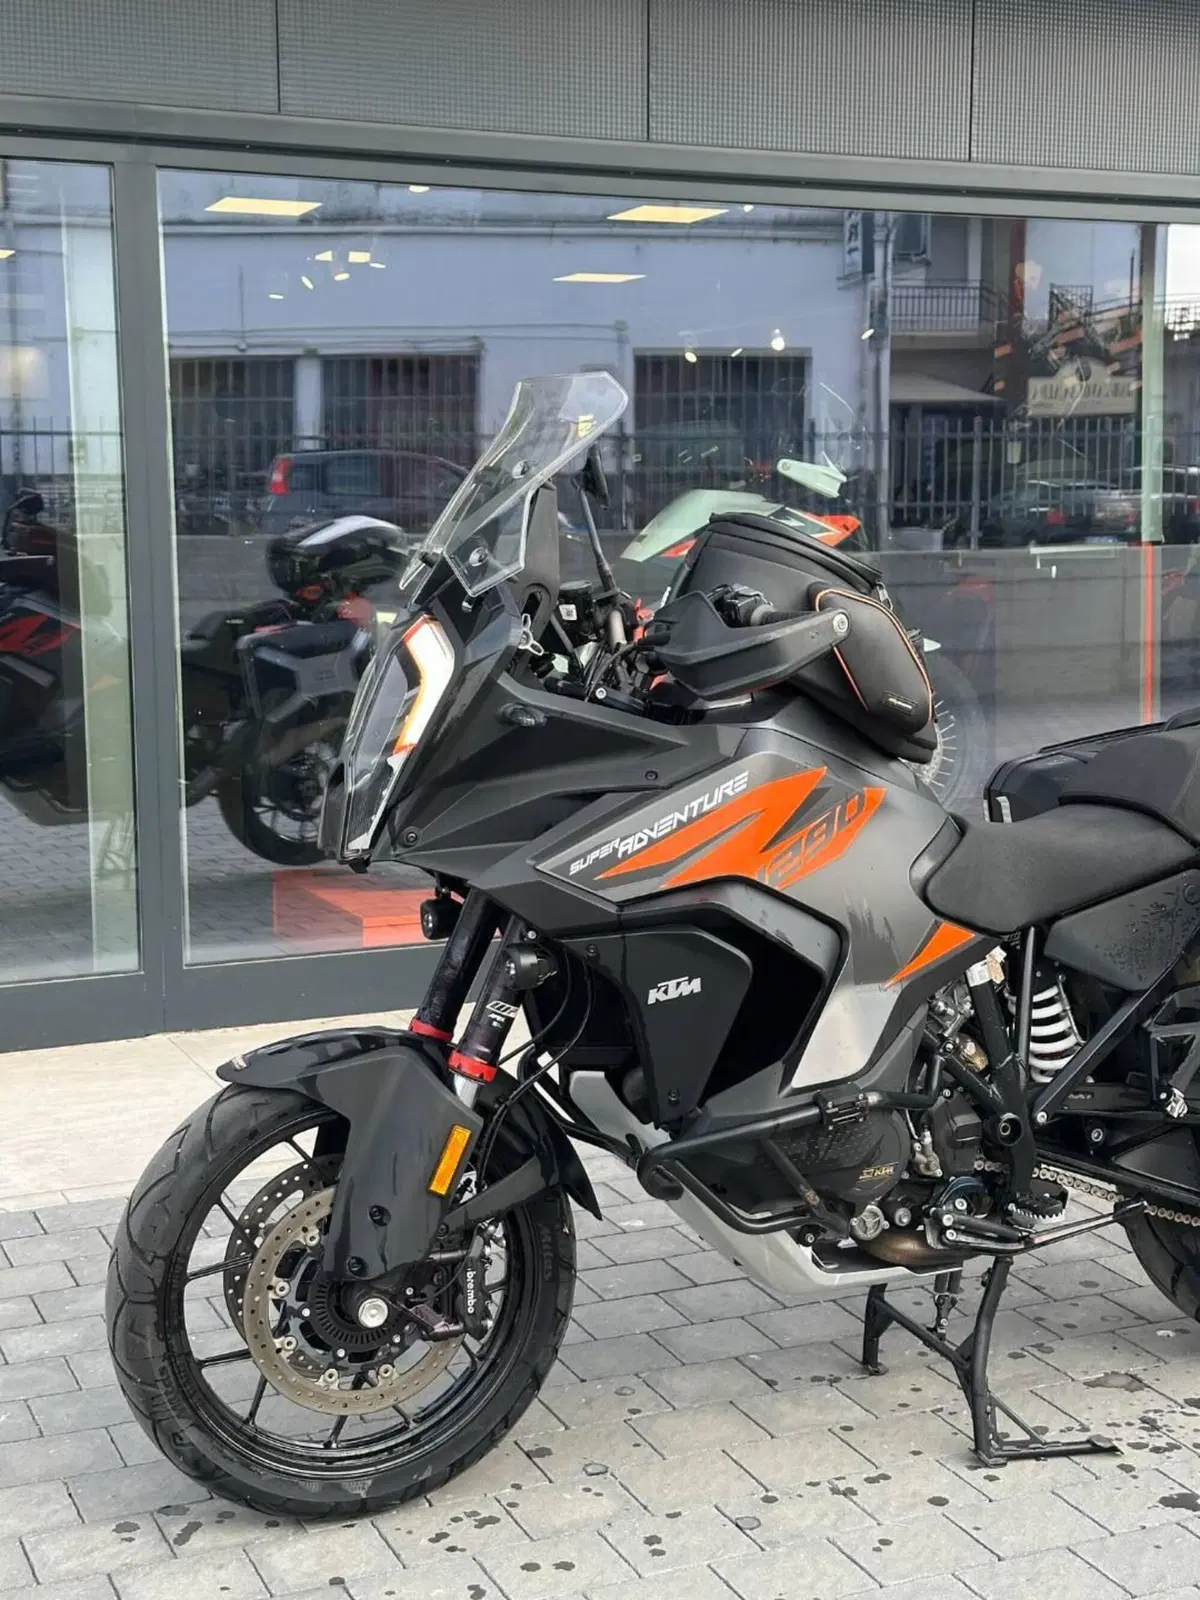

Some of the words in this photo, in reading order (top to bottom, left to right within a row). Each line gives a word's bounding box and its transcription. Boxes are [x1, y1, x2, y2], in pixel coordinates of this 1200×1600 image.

[569, 837, 621, 876] SUPER
[617, 770, 749, 859] ADVENTURE
[647, 976, 701, 1005] KTM
[466, 1270, 477, 1314] brembo
